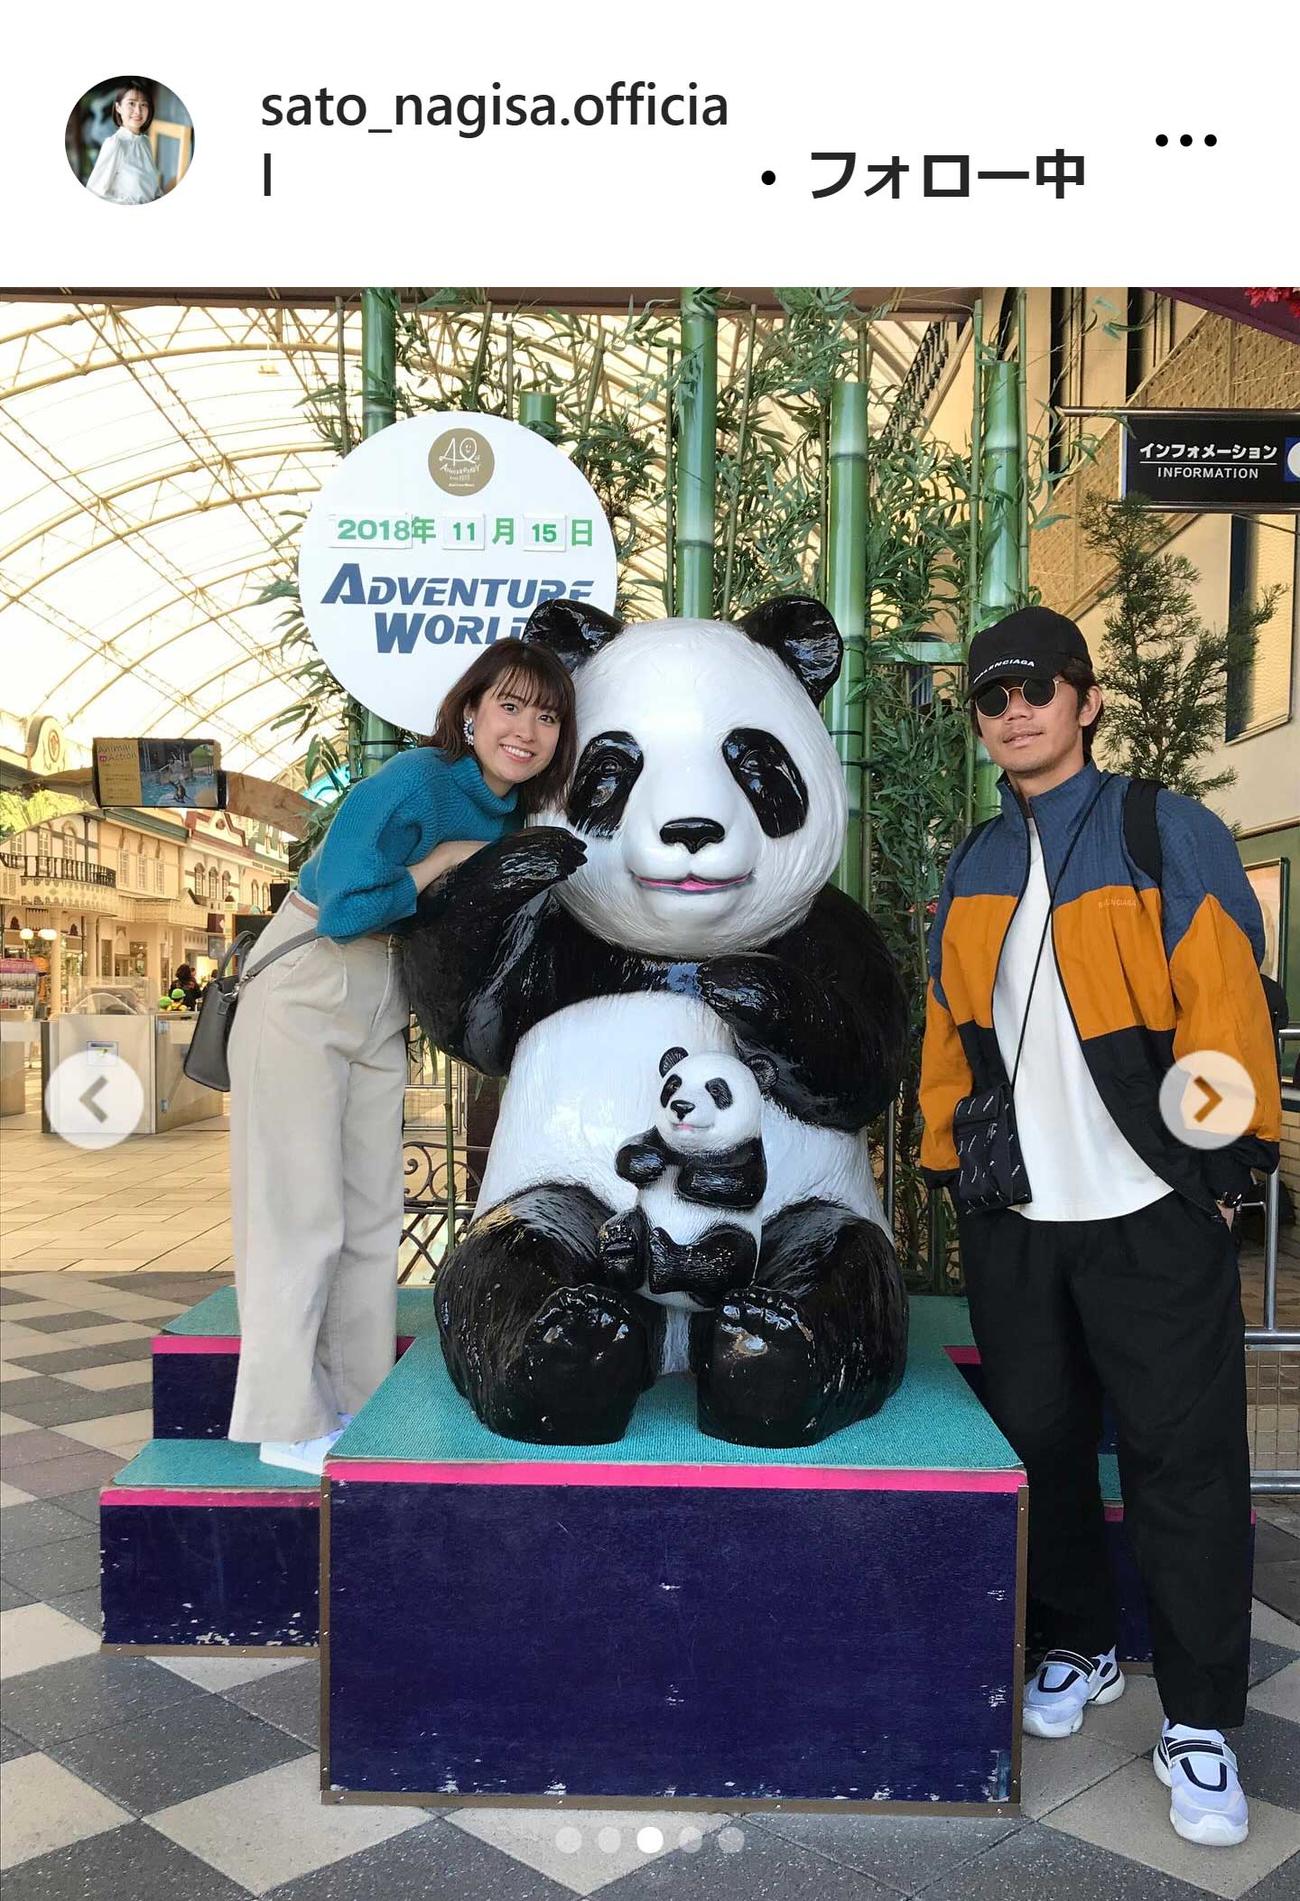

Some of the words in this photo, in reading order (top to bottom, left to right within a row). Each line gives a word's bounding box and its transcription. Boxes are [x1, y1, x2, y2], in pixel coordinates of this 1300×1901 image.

[1139, 443, 1278, 460] インフォメーション
[1157, 467, 1259, 479] INFORMATION
